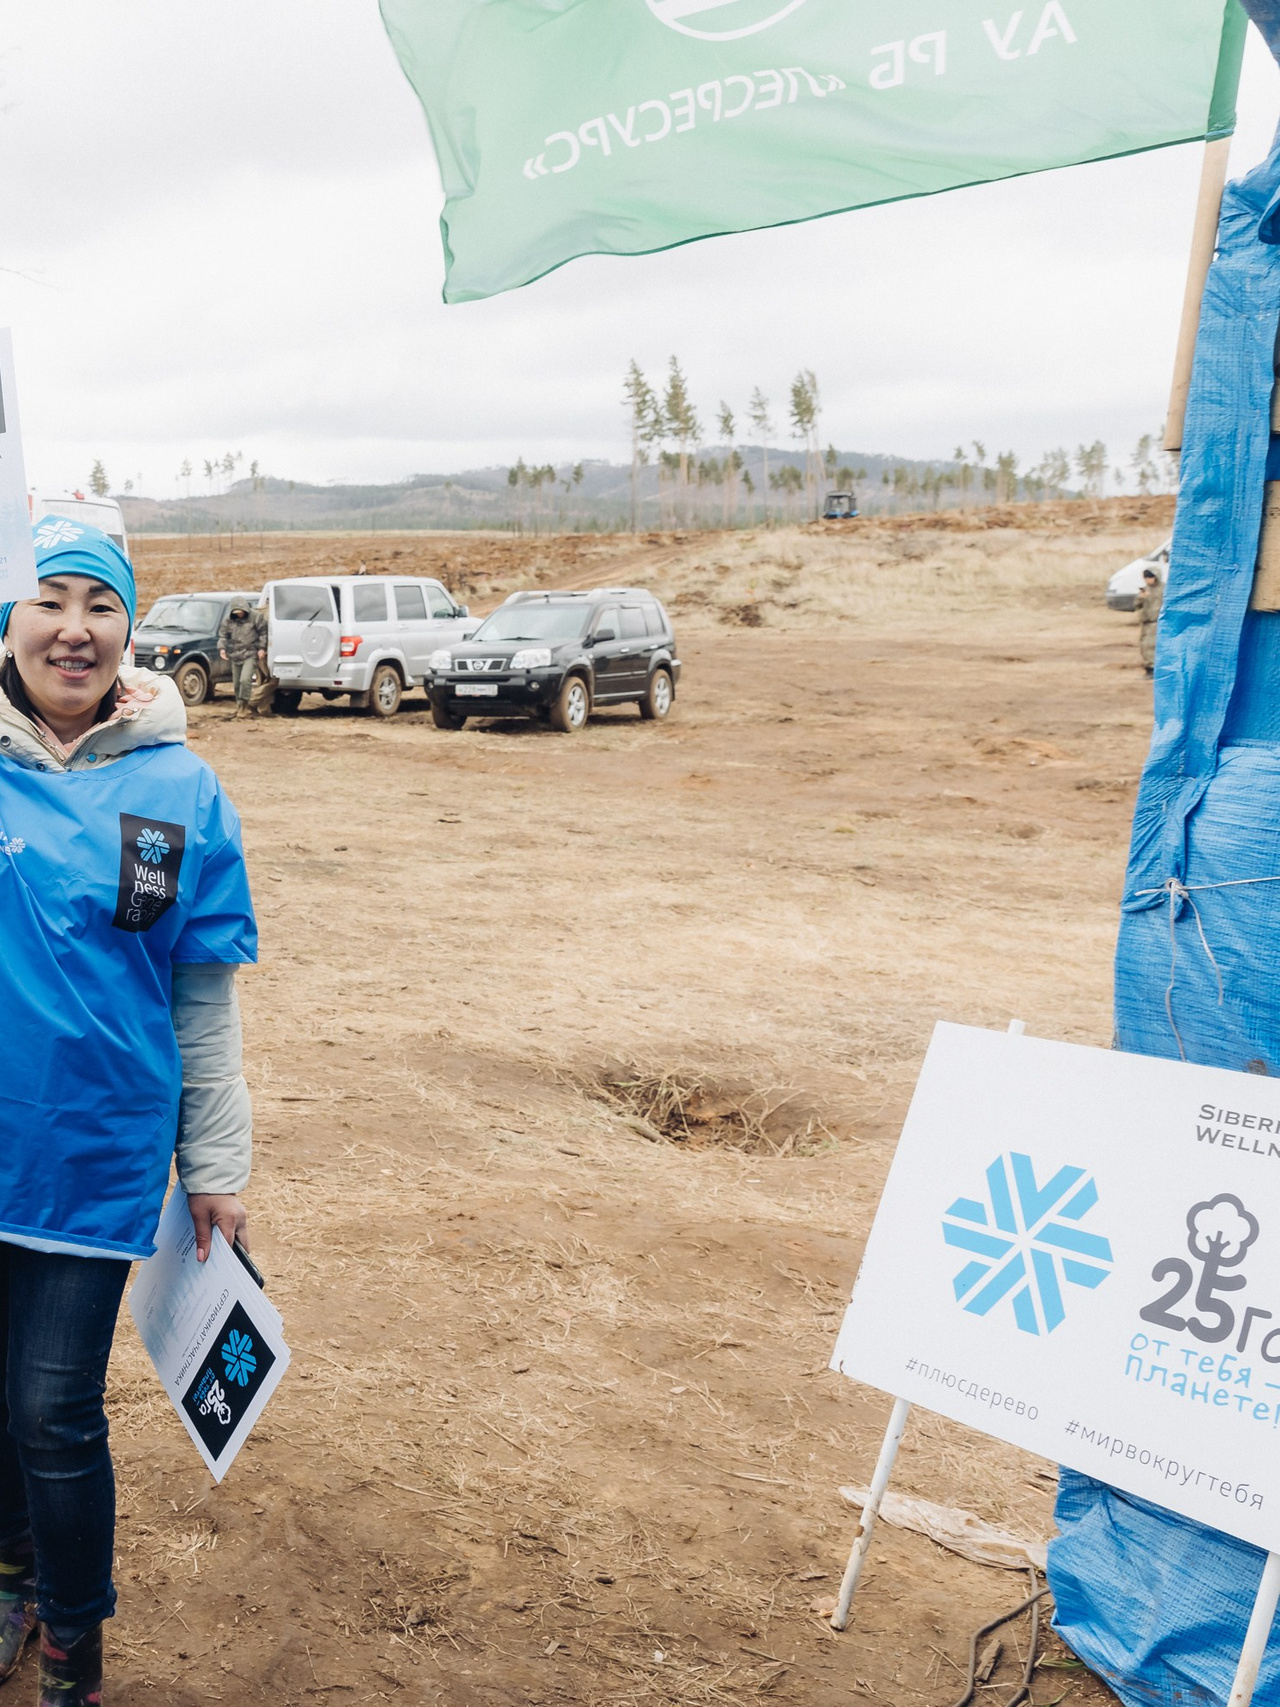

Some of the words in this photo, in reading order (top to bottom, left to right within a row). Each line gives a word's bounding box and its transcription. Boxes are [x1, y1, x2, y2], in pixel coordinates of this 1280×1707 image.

[134, 864, 165, 887] Well
[135, 880, 166, 899] ness
[200, 1288, 230, 1343] СЕРТИФИКАТ
[175, 1339, 201, 1386] УЧАСТНИКА
[1130, 1333, 1169, 1356] от
[1181, 1348, 1251, 1388] тебя
[905, 1357, 1039, 1421] #плюсдерево
[1124, 1353, 1280, 1429] планете!
[1064, 1419, 1264, 1511] #мирвокругтебя
